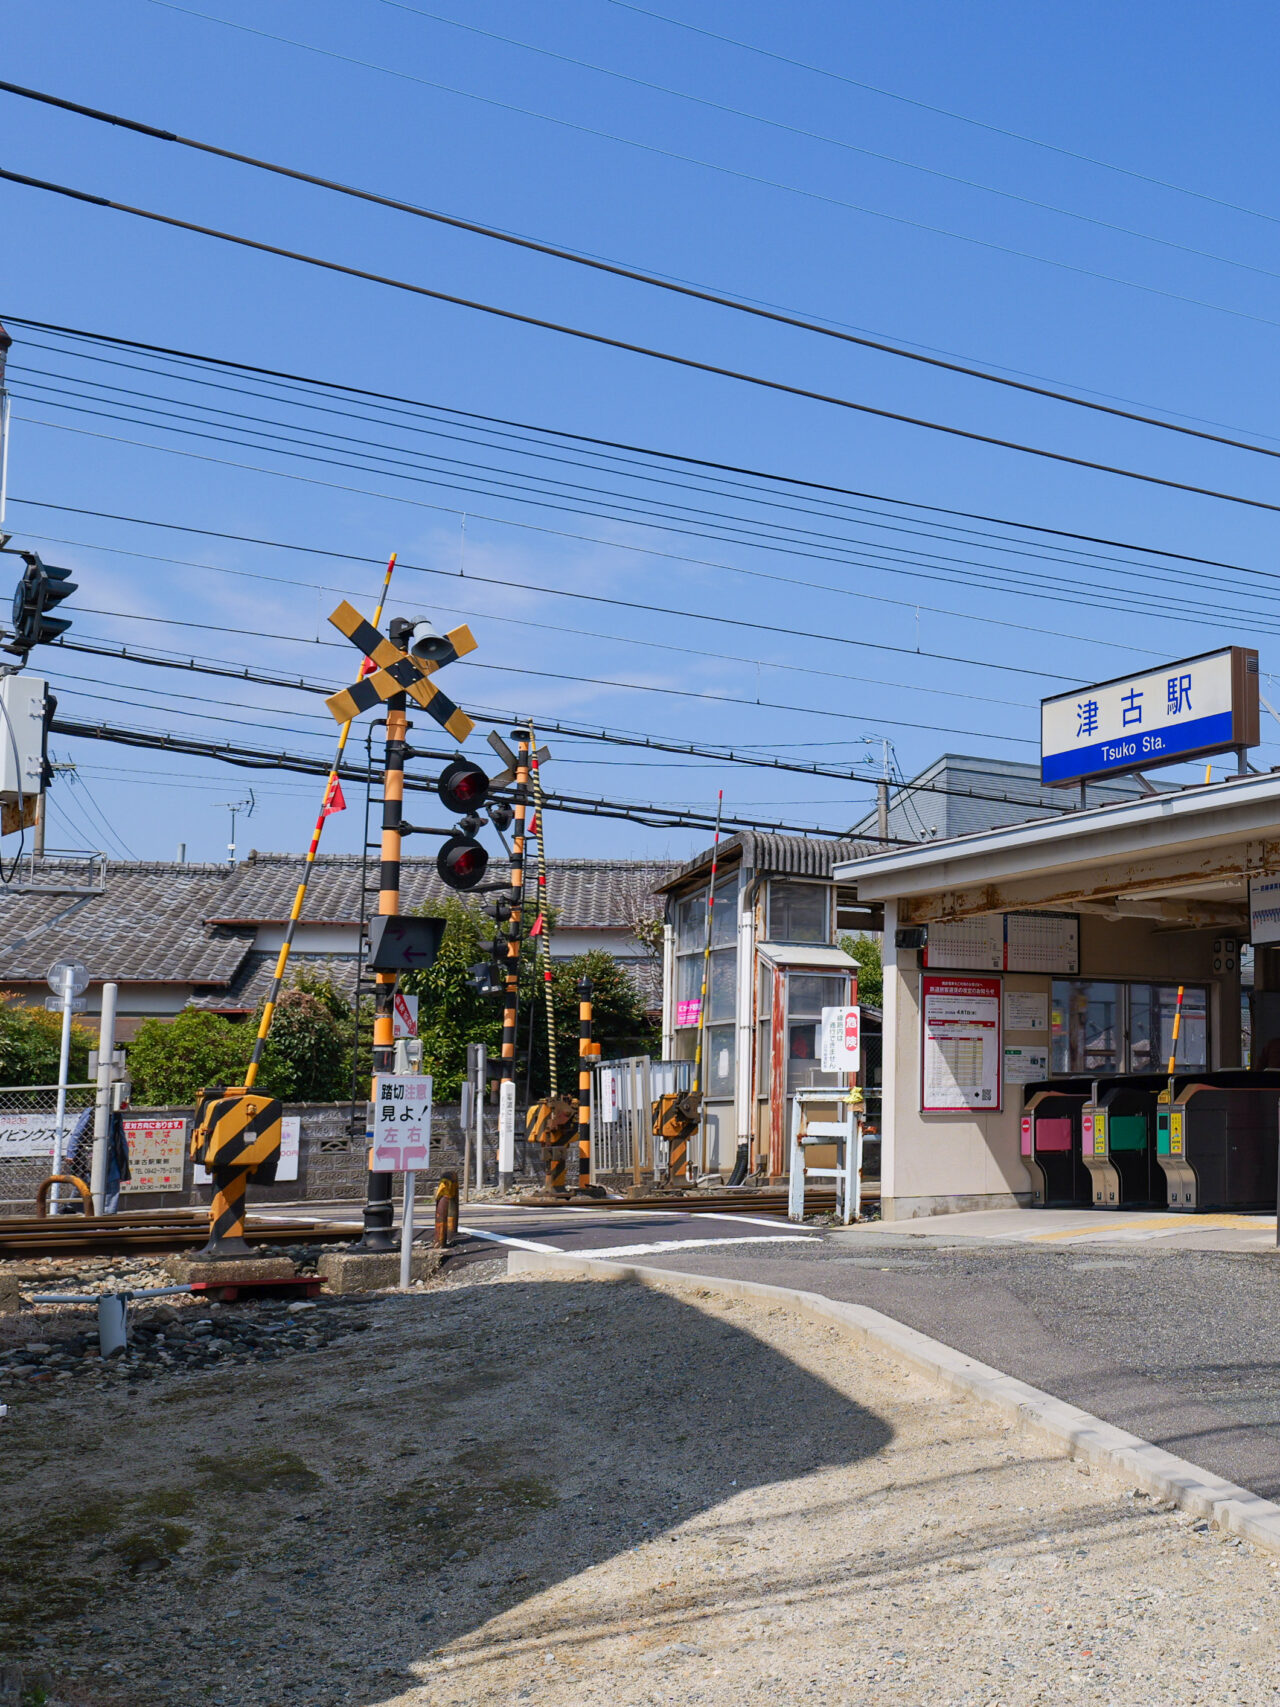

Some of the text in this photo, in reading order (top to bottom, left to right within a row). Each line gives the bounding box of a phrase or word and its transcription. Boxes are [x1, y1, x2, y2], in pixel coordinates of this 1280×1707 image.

[1076, 674, 1192, 738] 津古駅
[1101, 735, 1166, 761] Tsuko Sta.
[846, 1016, 857, 1047] 危険
[381, 1083, 427, 1100] 踏切注意
[384, 1126, 422, 1143] 左 右
